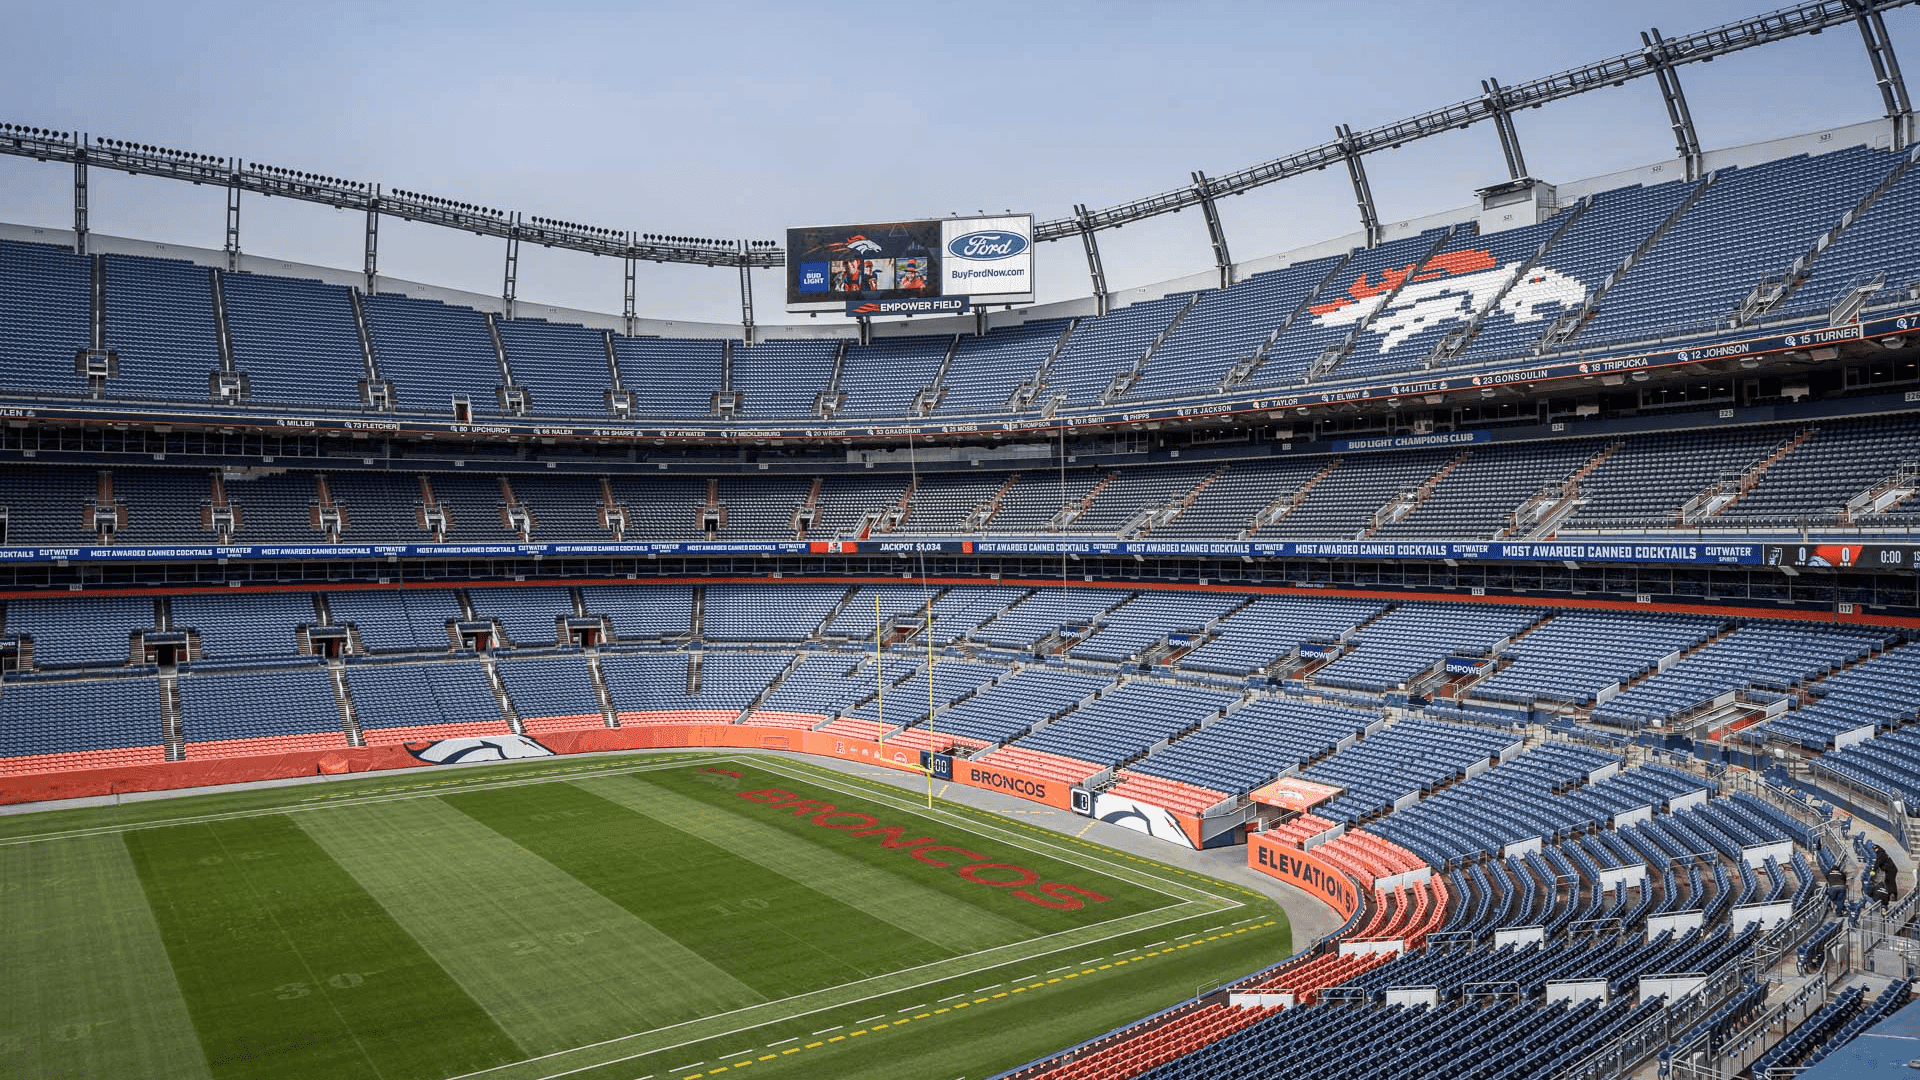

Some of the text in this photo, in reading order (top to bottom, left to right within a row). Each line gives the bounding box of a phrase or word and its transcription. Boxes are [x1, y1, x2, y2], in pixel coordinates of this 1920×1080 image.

[964, 235, 1012, 256] Ford
[952, 269, 1024, 279] BuyFordNow.com
[880, 300, 962, 312] EMPOWER FIELD
[1800, 327, 1858, 344] 15 TURNER
[1690, 344, 1749, 359] 12 JOHNSON
[1603, 358, 1648, 370] TRIPUCKA
[1495, 370, 1548, 383] GONSOULIN
[1412, 383, 1437, 392] LITTLE
[1337, 392, 1360, 400] ELWAY
[1272, 398, 1298, 407] TAYLOR
[1200, 405, 1231, 414] JACKSON
[1348, 433, 1473, 449] BUD LIGHT CHAMPIONS CLUB
[916, 543, 941, 551] $1,034
[979, 543, 996, 551] MOST
[997, 543, 1027, 551] AWARDED
[1056, 543, 1089, 552] COCKTAILS
[1127, 543, 1249, 553] MOST AWARDED CANNED COCKTAILS
[1296, 544, 1447, 556] MOST AWARDED CANNED COCKTAILS
[1503, 545, 1696, 559] MOST AWARDED CANNED COCKTAILS
[1705, 547, 1752, 556] CUTWATER
[1799, 547, 1806, 562] 0
[1842, 548, 1849, 562] 0
[1881, 550, 1901, 563] 0:00
[1446, 664, 1480, 674] EMPOWE
[971, 769, 1046, 798] BRONCOS
[736, 788, 1112, 911] BRONCOS
[1258, 845, 1342, 904] ELEVATION
